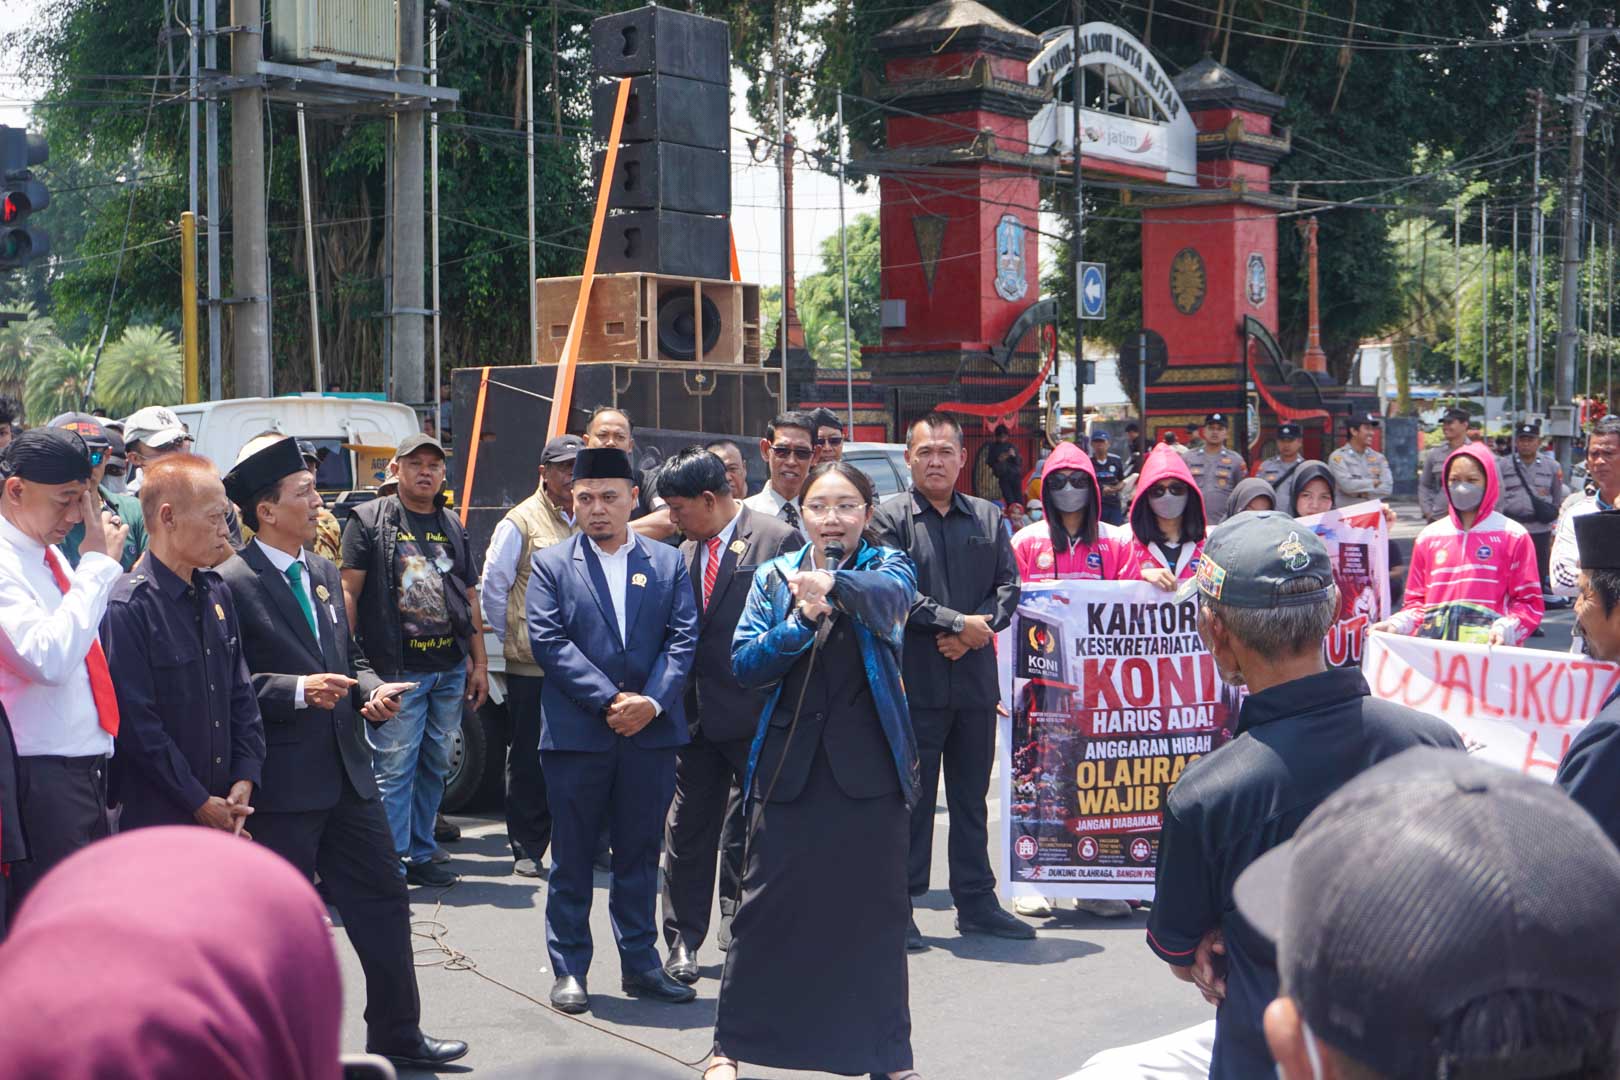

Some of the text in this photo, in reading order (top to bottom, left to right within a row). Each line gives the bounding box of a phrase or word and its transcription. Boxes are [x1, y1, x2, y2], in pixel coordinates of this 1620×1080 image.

[1116, 38, 1142, 73] KOTA
[1144, 62, 1180, 120] BLITAR
[1107, 127, 1137, 147] jatim
[1087, 601, 1196, 635] KANTOR
[1327, 614, 1368, 667] UT
[1028, 655, 1058, 672] KONI
[1083, 654, 1215, 709] KONI
[1093, 705, 1214, 734] HARUS ADA!
[1085, 736, 1212, 760] ANGGARAN HIBAH
[1523, 731, 1570, 776] H
[1076, 754, 1201, 789] OLAHRA
[1077, 785, 1160, 815] WAJIB
[1076, 818, 1111, 831] JANGAN
[1048, 868, 1077, 878] DUKUNG
[1116, 869, 1143, 878] BANGUN
